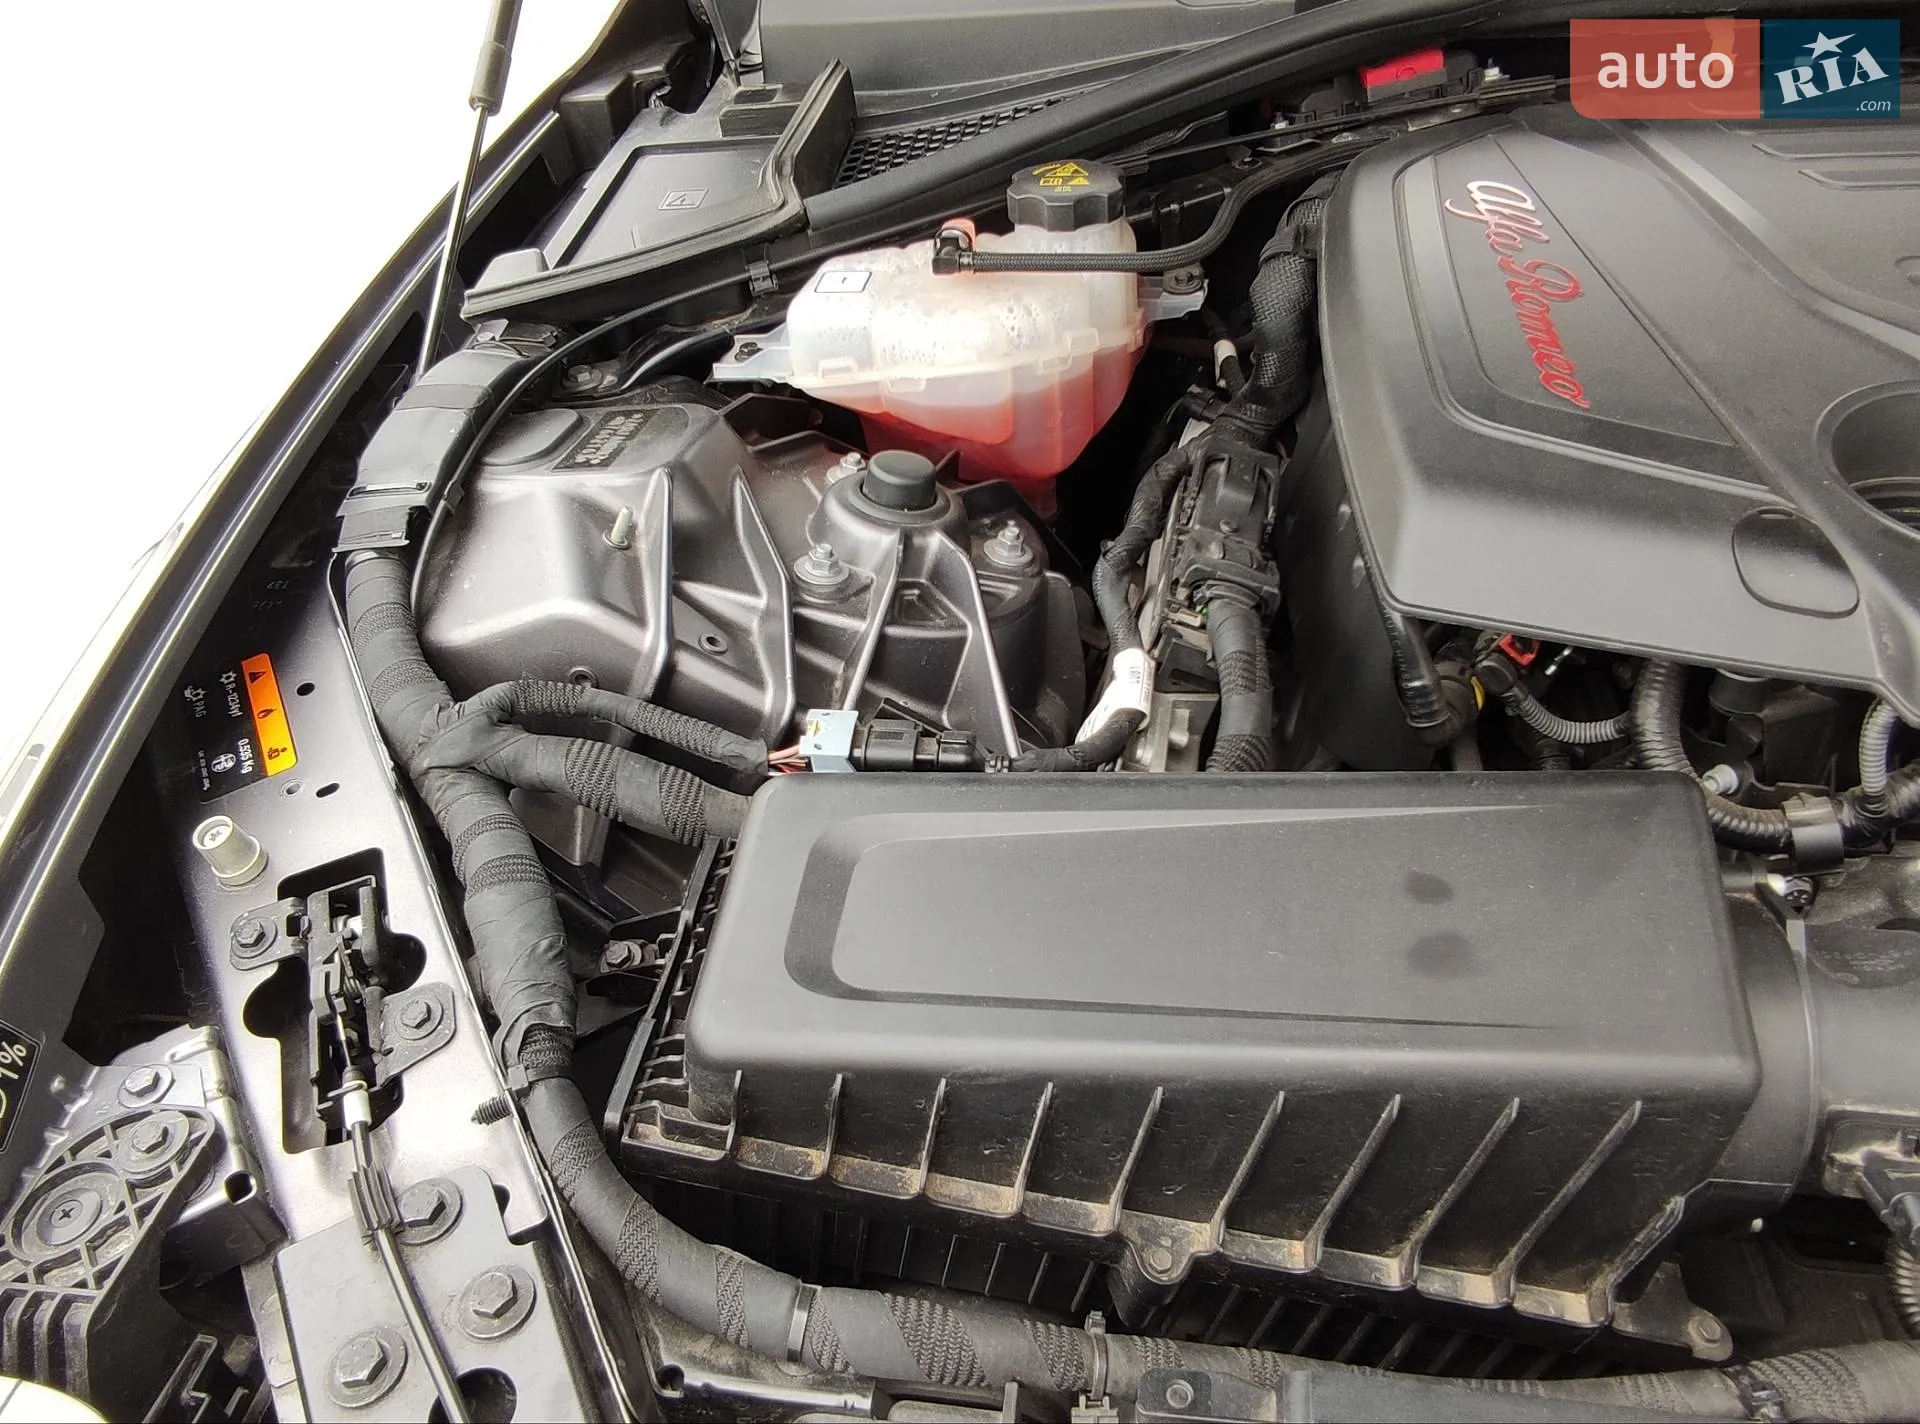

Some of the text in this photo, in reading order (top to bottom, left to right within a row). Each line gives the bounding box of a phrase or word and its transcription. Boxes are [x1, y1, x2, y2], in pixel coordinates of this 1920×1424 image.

[1445, 181, 1590, 409] Alfa Romeo
[193, 701, 207, 718] PAG
[238, 738, 253, 761] 0.535
